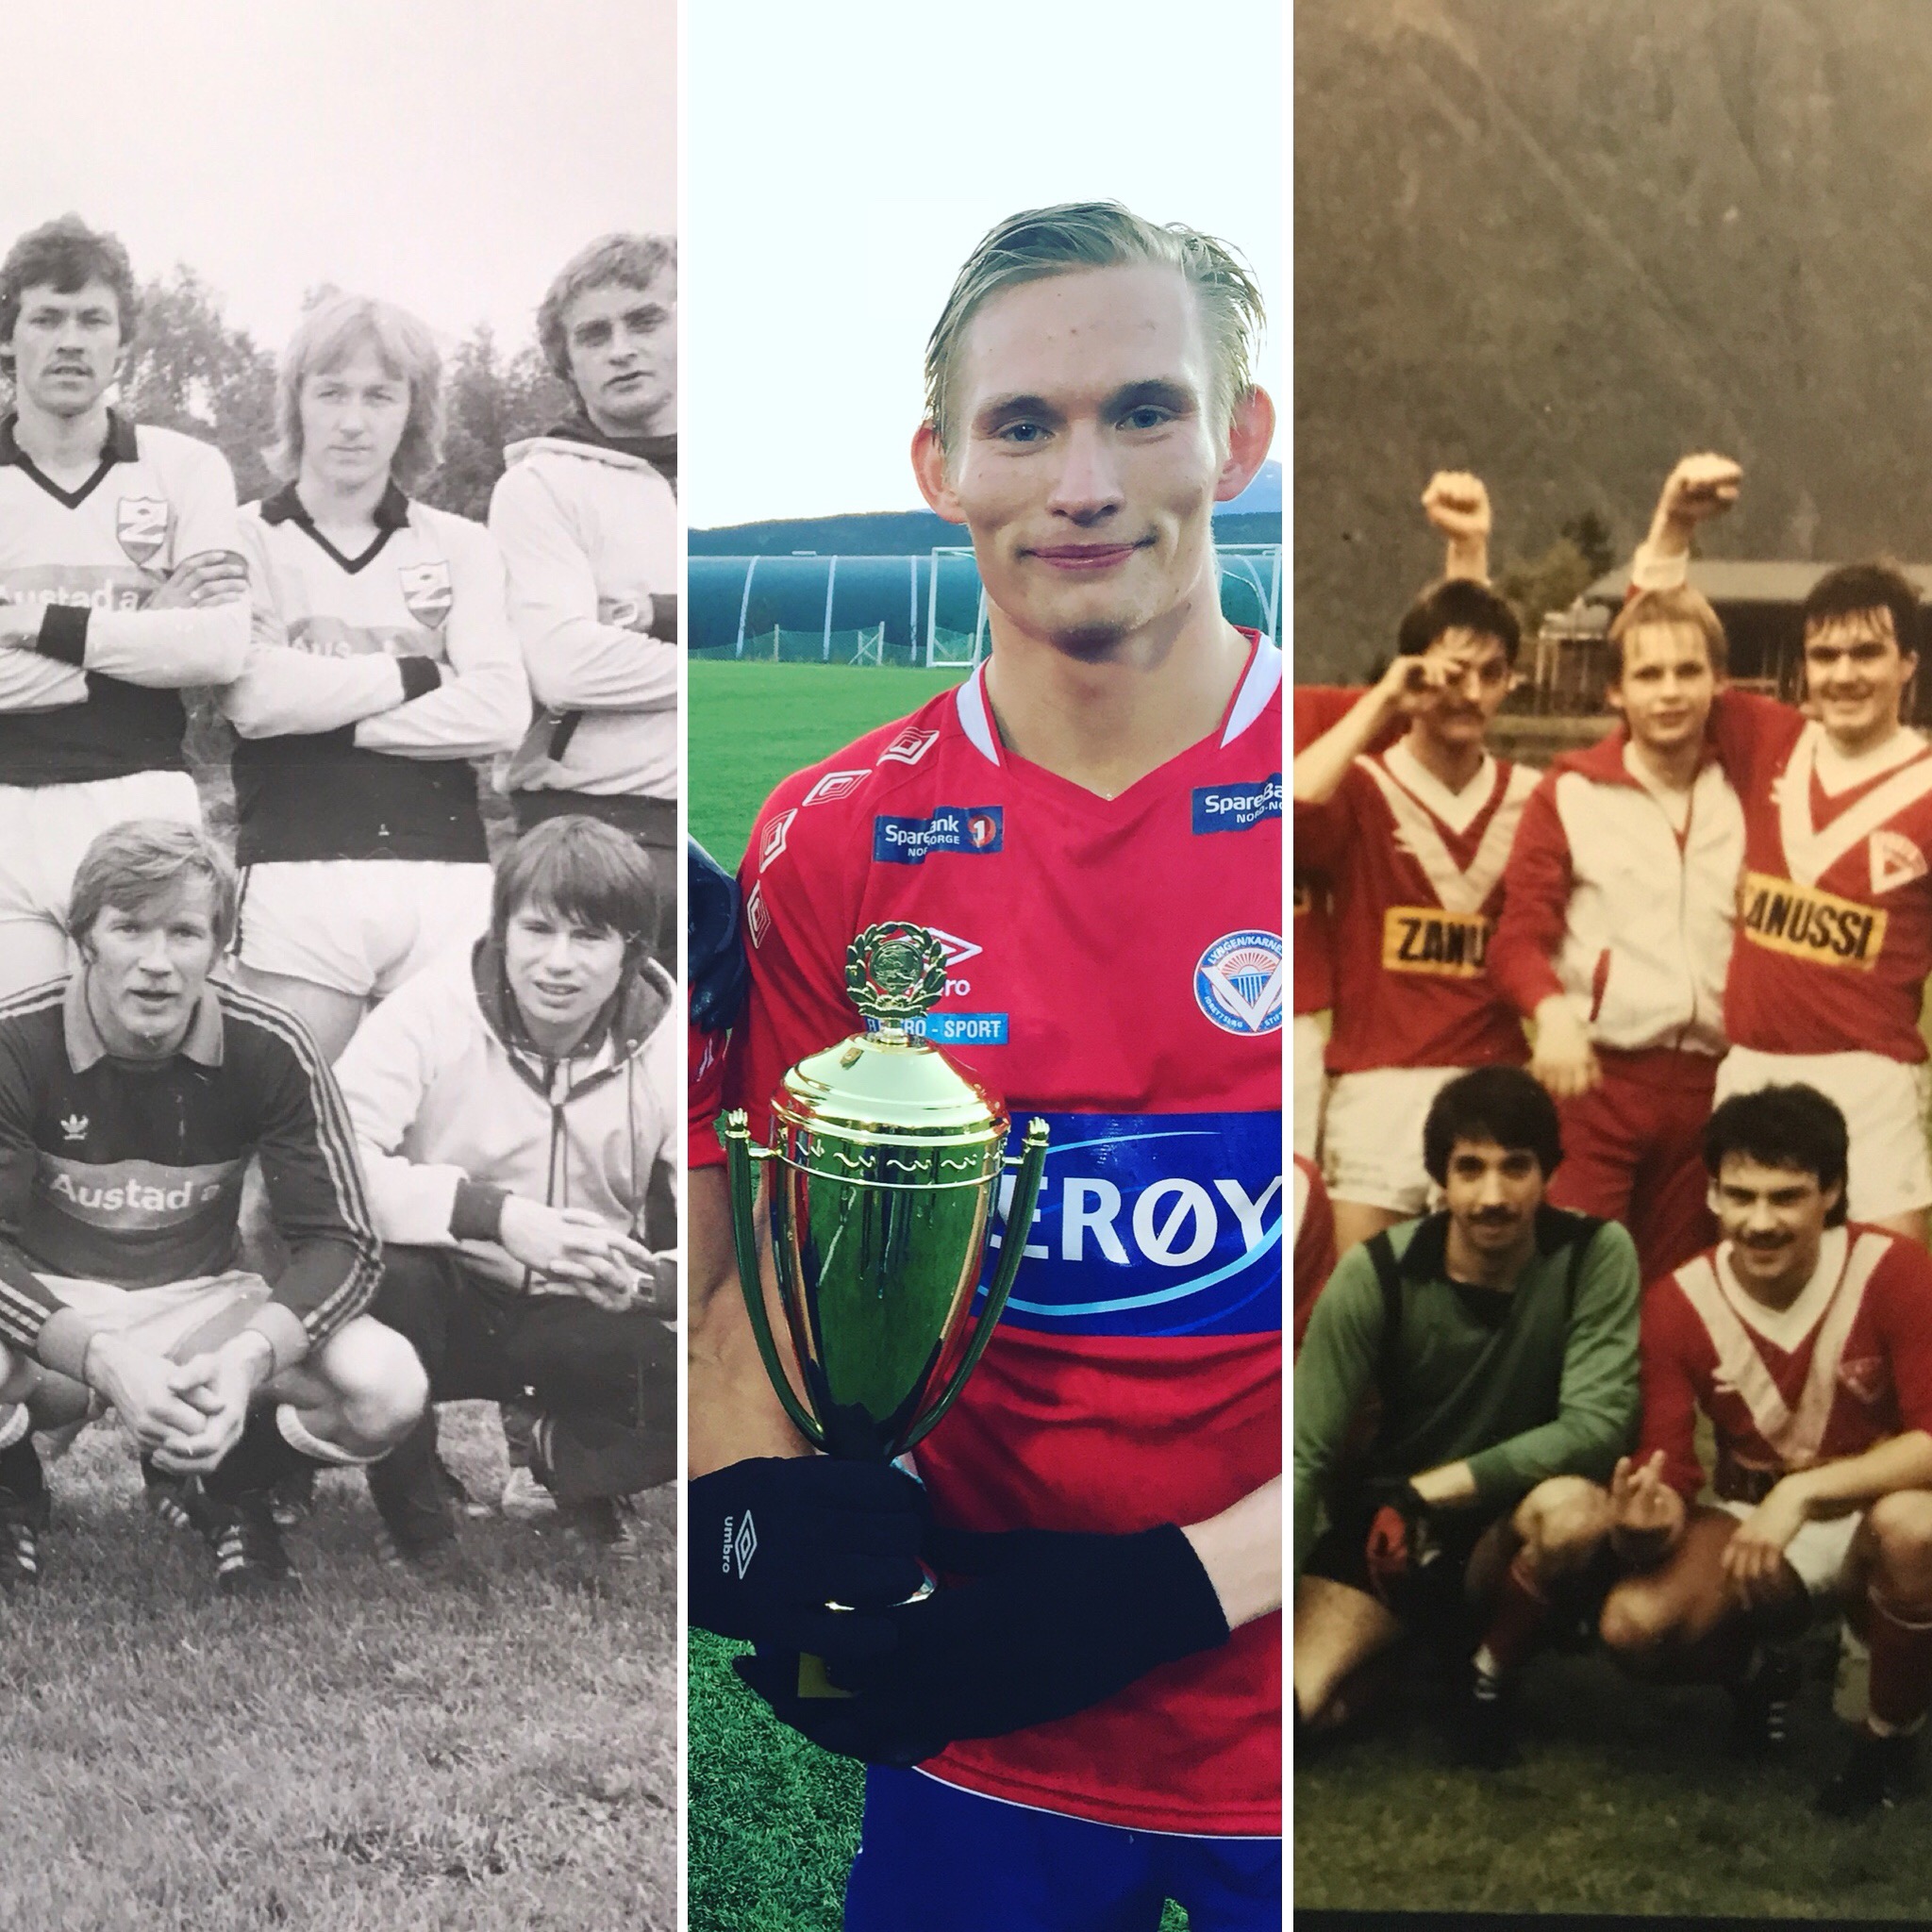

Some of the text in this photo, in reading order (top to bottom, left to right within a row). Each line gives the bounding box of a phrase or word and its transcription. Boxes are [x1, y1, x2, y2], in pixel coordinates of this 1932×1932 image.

[885, 815, 959, 845] Spareank
[944, 1020, 1001, 1039] SPORT
[51, 1173, 193, 1212] Austad
[990, 1174, 1282, 1267] ERØY
[722, 1515, 734, 1574] umbro
